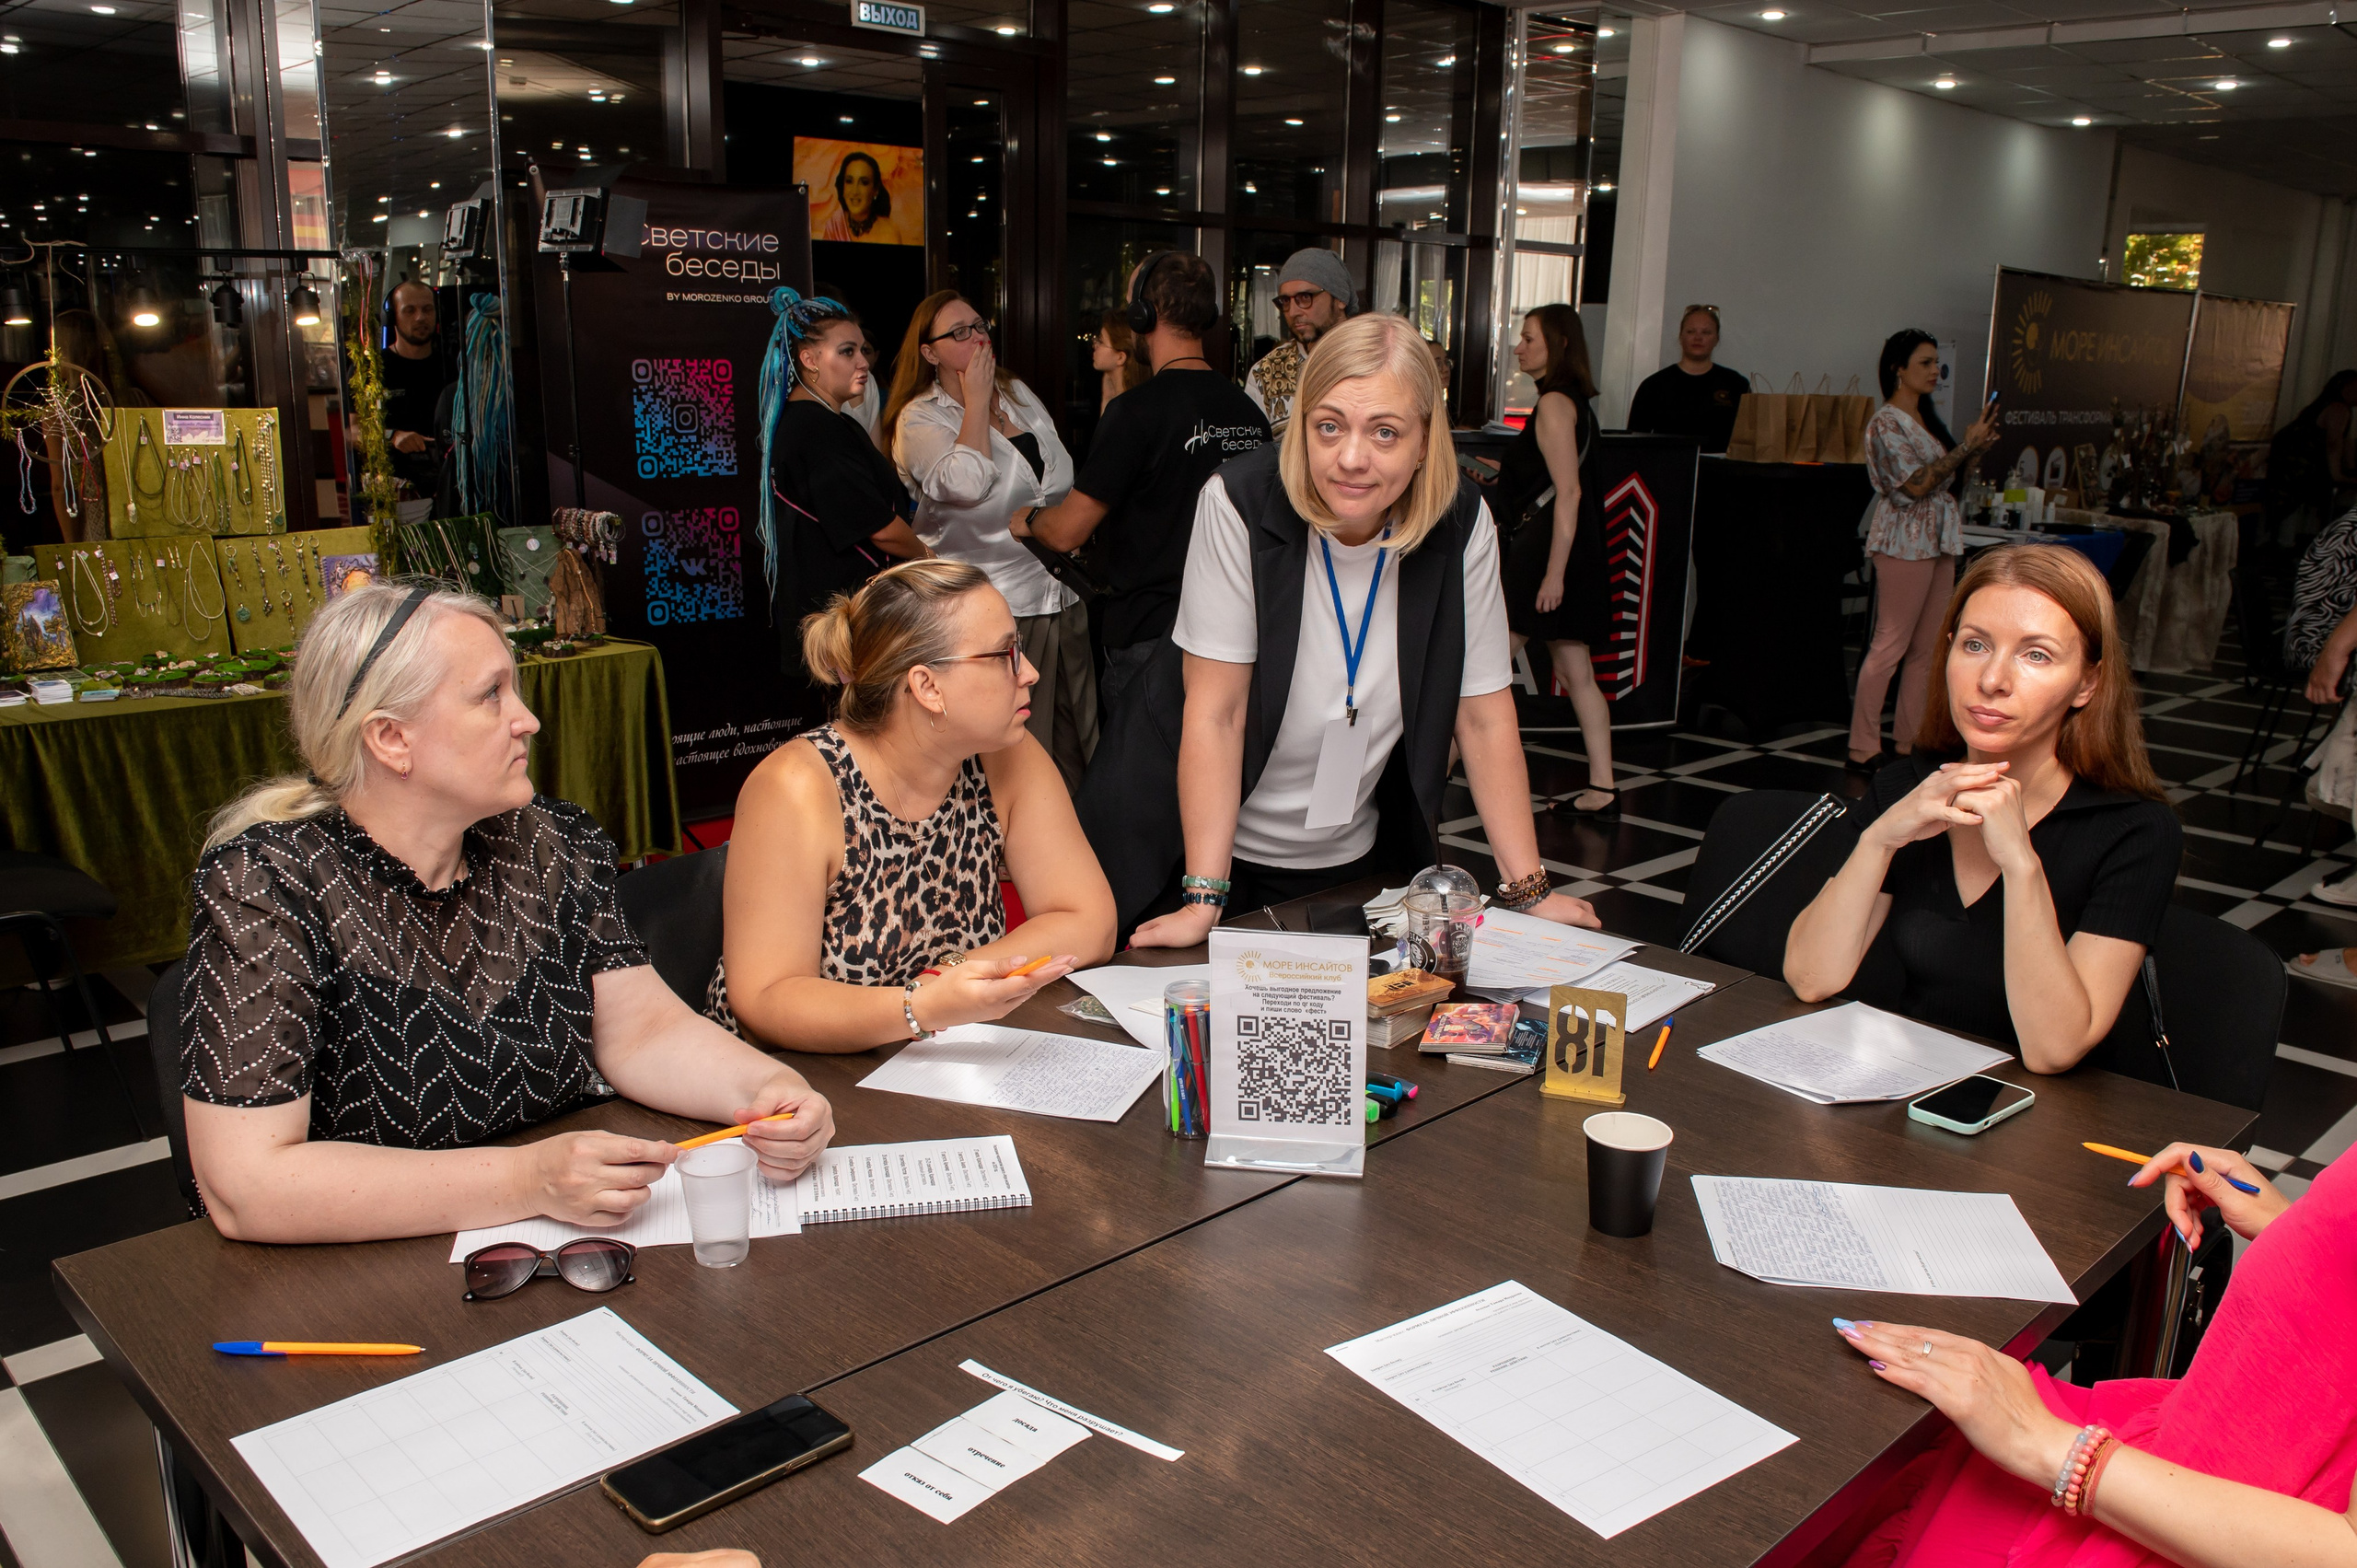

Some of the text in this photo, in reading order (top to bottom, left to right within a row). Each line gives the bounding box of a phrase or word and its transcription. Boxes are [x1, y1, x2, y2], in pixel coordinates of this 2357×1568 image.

[860, 2, 918, 29] ВЫХОД
[667, 251, 780, 284] беседы
[667, 292, 679, 301] BY
[682, 293, 742, 303] MOROZENKO
[708, 723, 740, 738] люди,
[743, 716, 803, 733] настоящие
[673, 748, 730, 766] астоящее
[1263, 960, 1353, 972] МОРЕ ИНСАЙТОВ
[1323, 973, 1341, 981] клуб
[1261, 993, 1296, 1001] следующий
[1298, 993, 1335, 1002] фестиваль?
[1301, 987, 1341, 995] предложение
[1262, 999, 1289, 1007] Переходи
[993, 1377, 1007, 1388] чего
[1013, 1386, 1045, 1402] убегаю?
[1045, 1399, 1058, 1409] Что
[1058, 1406, 1079, 1418] меня
[1077, 1414, 1124, 1436] разрушает?
[1012, 1417, 1039, 1433] досада
[968, 1446, 1006, 1469] отречение
[904, 1471, 954, 1502] отказ от себя
